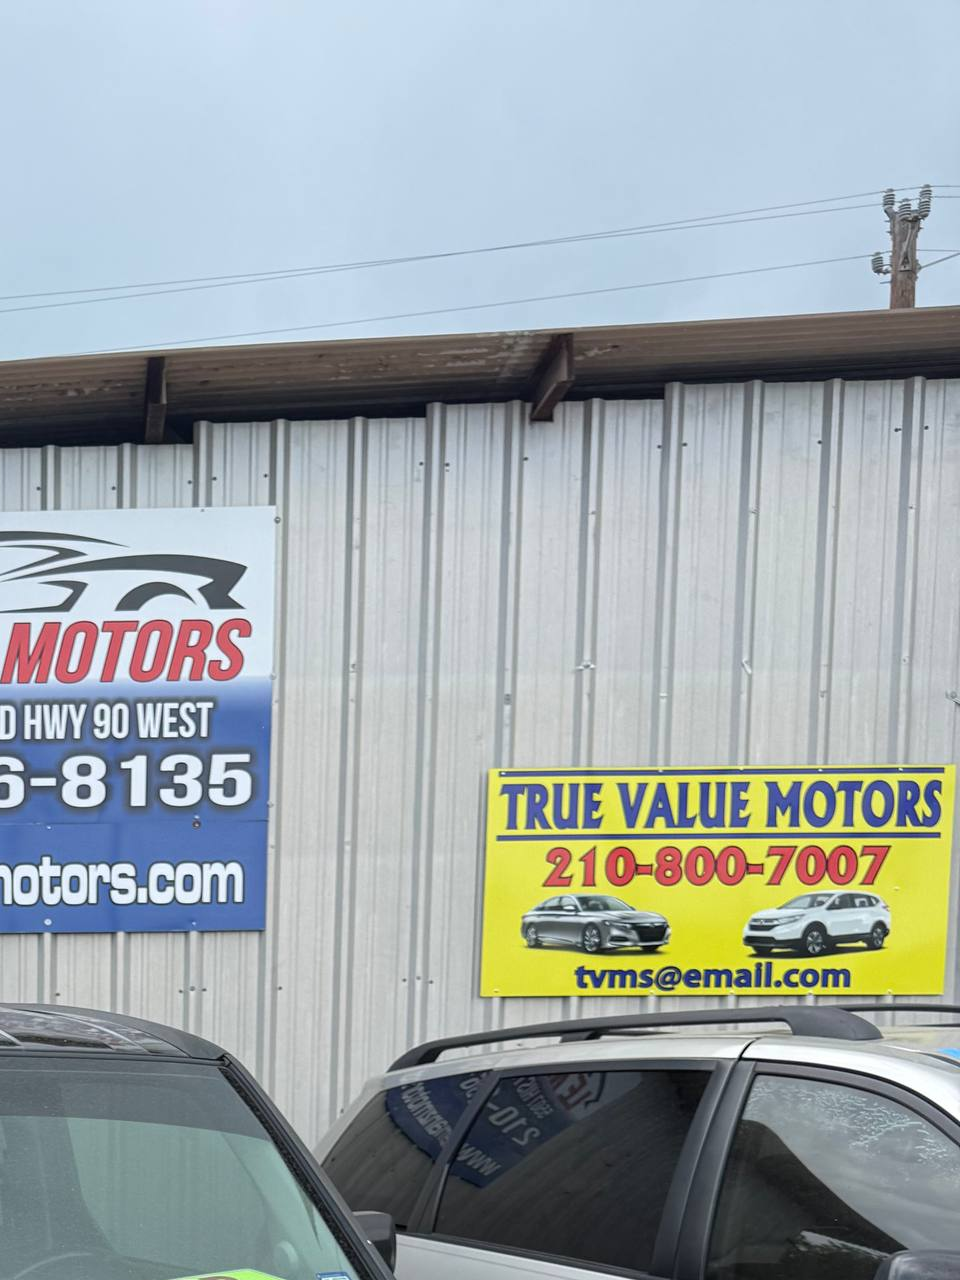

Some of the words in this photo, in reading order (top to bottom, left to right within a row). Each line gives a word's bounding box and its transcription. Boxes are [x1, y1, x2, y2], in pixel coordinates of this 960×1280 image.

[0, 618, 253, 685] MOTORS
[23, 703, 86, 740] HWY
[93, 702, 127, 740] 90
[136, 701, 214, 739] WEST
[499, 782, 604, 831] TRUE
[616, 780, 751, 830] VALUE
[764, 779, 942, 828] MOTORS
[542, 844, 892, 888] 210-800-7007
[574, 961, 851, 991] tvms@email.com
